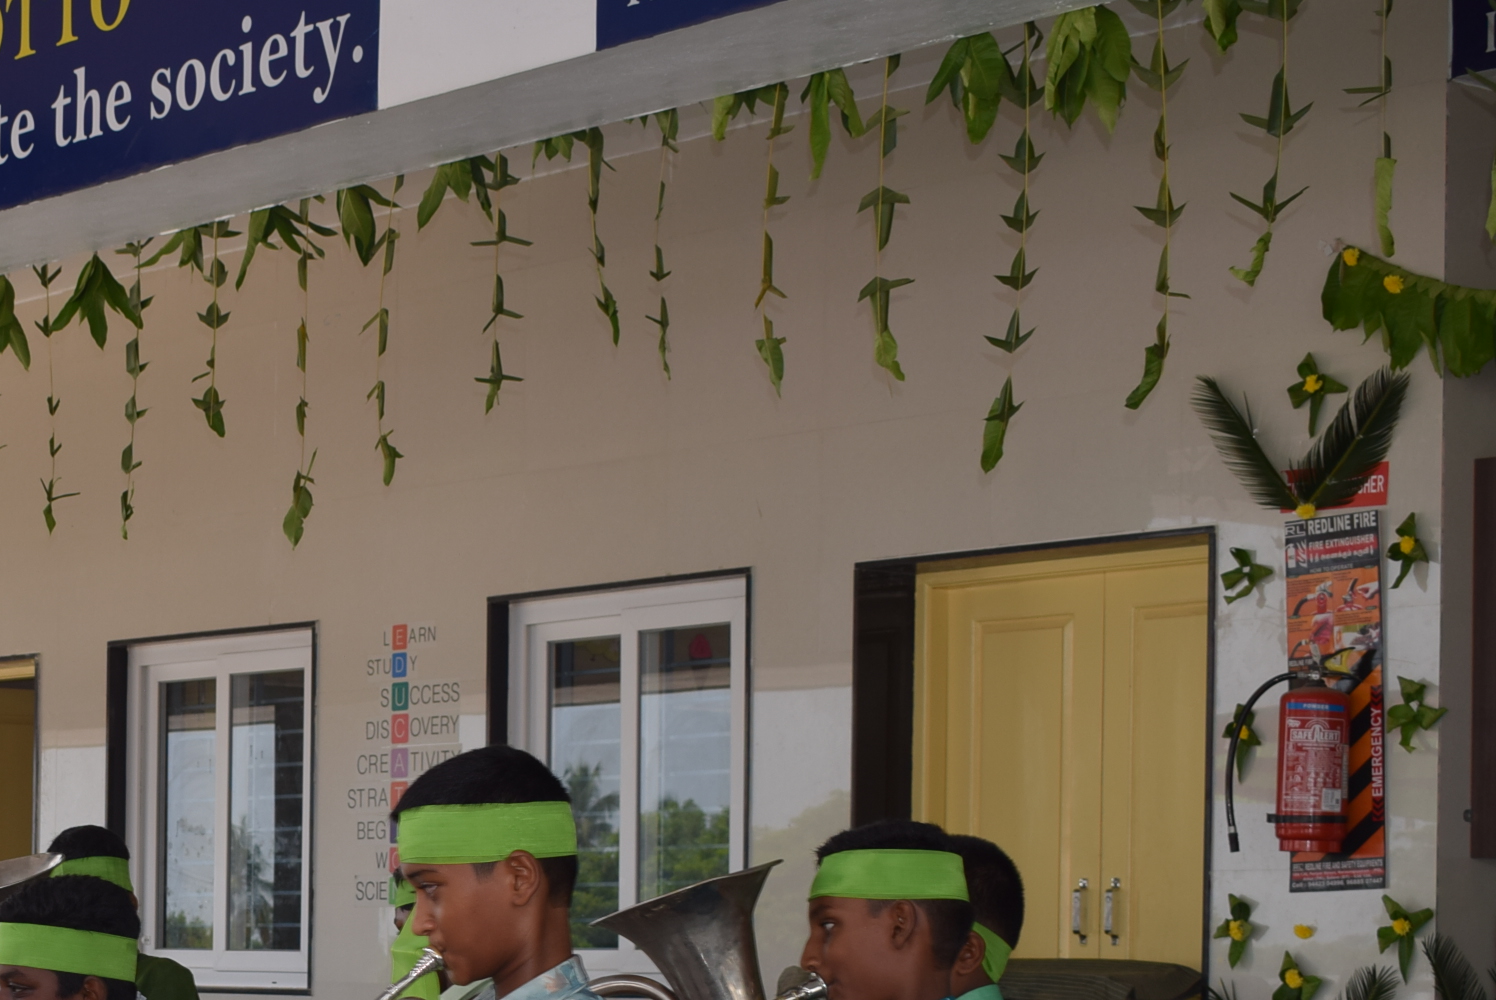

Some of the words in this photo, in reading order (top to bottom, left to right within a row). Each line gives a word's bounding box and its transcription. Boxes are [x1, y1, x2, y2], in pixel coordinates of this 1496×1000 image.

[51, 67, 132, 146] the
[151, 11, 364, 120] society.
[1307, 515, 1351, 536] REDLINE
[1353, 511, 1377, 530] FIRE
[1308, 540, 1324, 551] FIRE
[1325, 534, 1375, 549] EXTINGUISHER
[383, 625, 437, 648] LEARN
[367, 654, 418, 677] STUDY
[380, 682, 460, 708] SUCCESS
[366, 714, 460, 741] DISCOVERY
[1292, 730, 1312, 740] SAFE
[1313, 725, 1338, 741] ALERT
[357, 749, 462, 776] CREATIVIT
[1370, 707, 1383, 797] EMERGENCY
[357, 820, 398, 841] BEG
